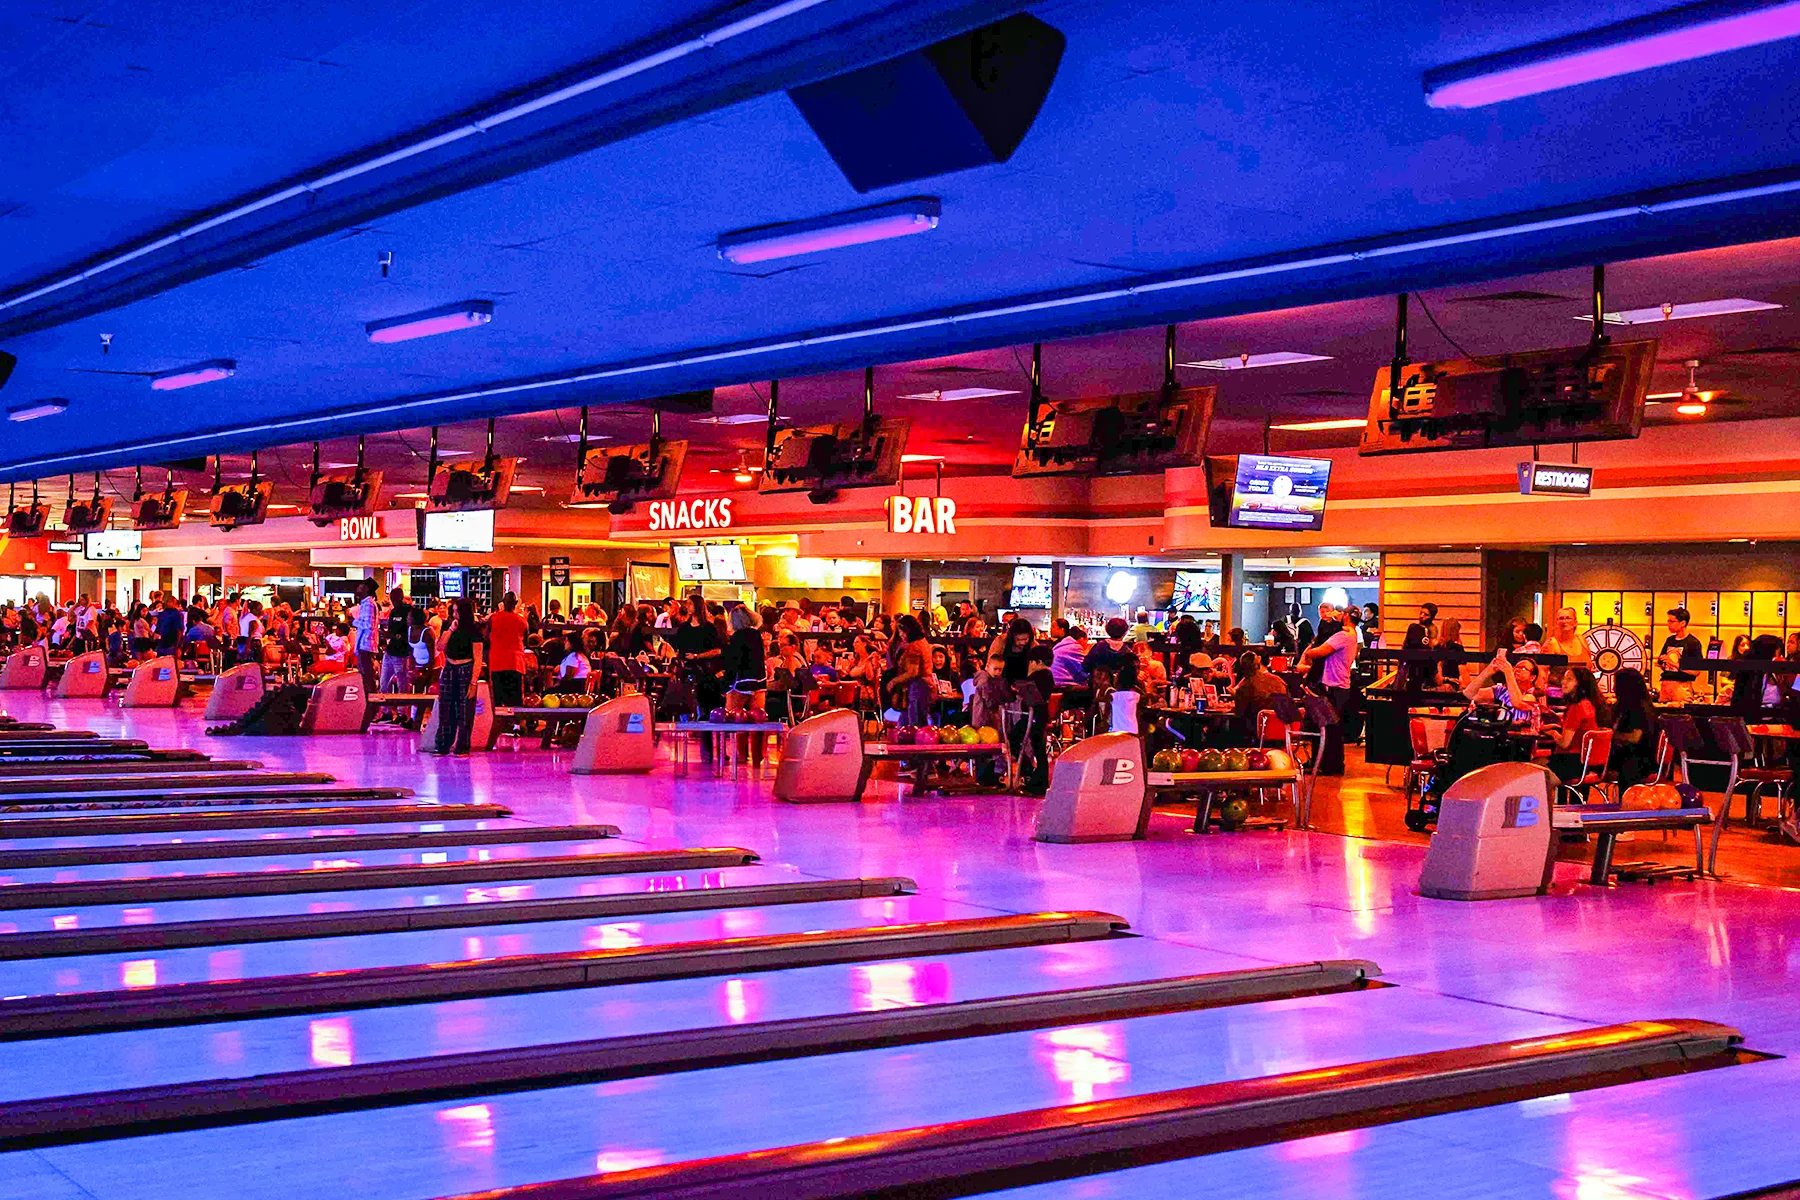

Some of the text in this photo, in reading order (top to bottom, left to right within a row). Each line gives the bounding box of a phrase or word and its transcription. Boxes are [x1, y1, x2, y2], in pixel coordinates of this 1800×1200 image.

[1535, 471, 1590, 488] RESTROOMS
[340, 516, 380, 540] BOWL
[648, 498, 732, 530] SNACKS
[889, 495, 956, 534] BAR
